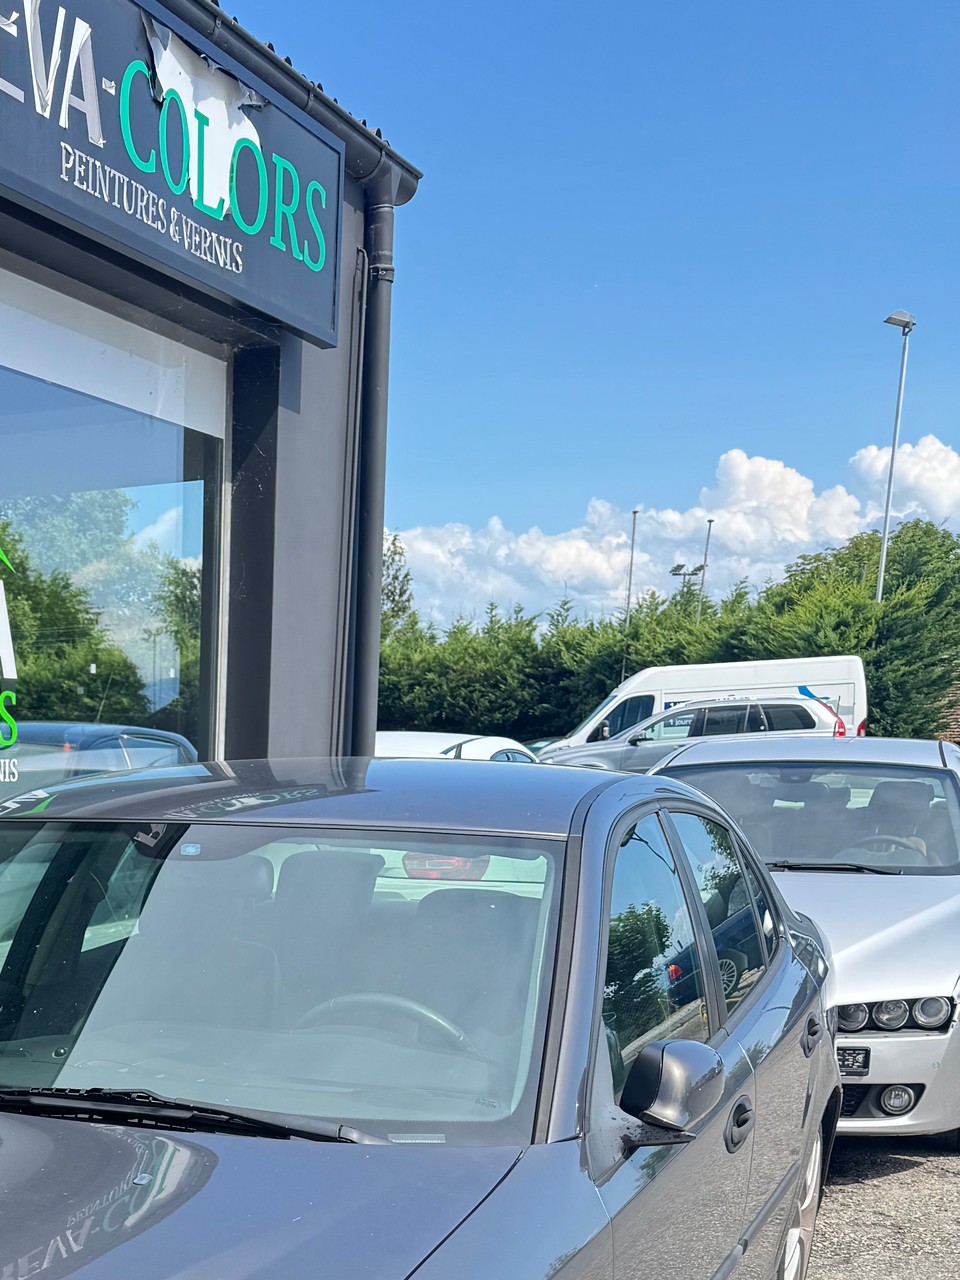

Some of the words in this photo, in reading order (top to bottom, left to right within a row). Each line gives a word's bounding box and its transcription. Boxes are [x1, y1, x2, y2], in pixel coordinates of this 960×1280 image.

[60, 141, 167, 234] PEINTURES
[169, 207, 182, 243] &
[181, 212, 244, 274] VERNIS
